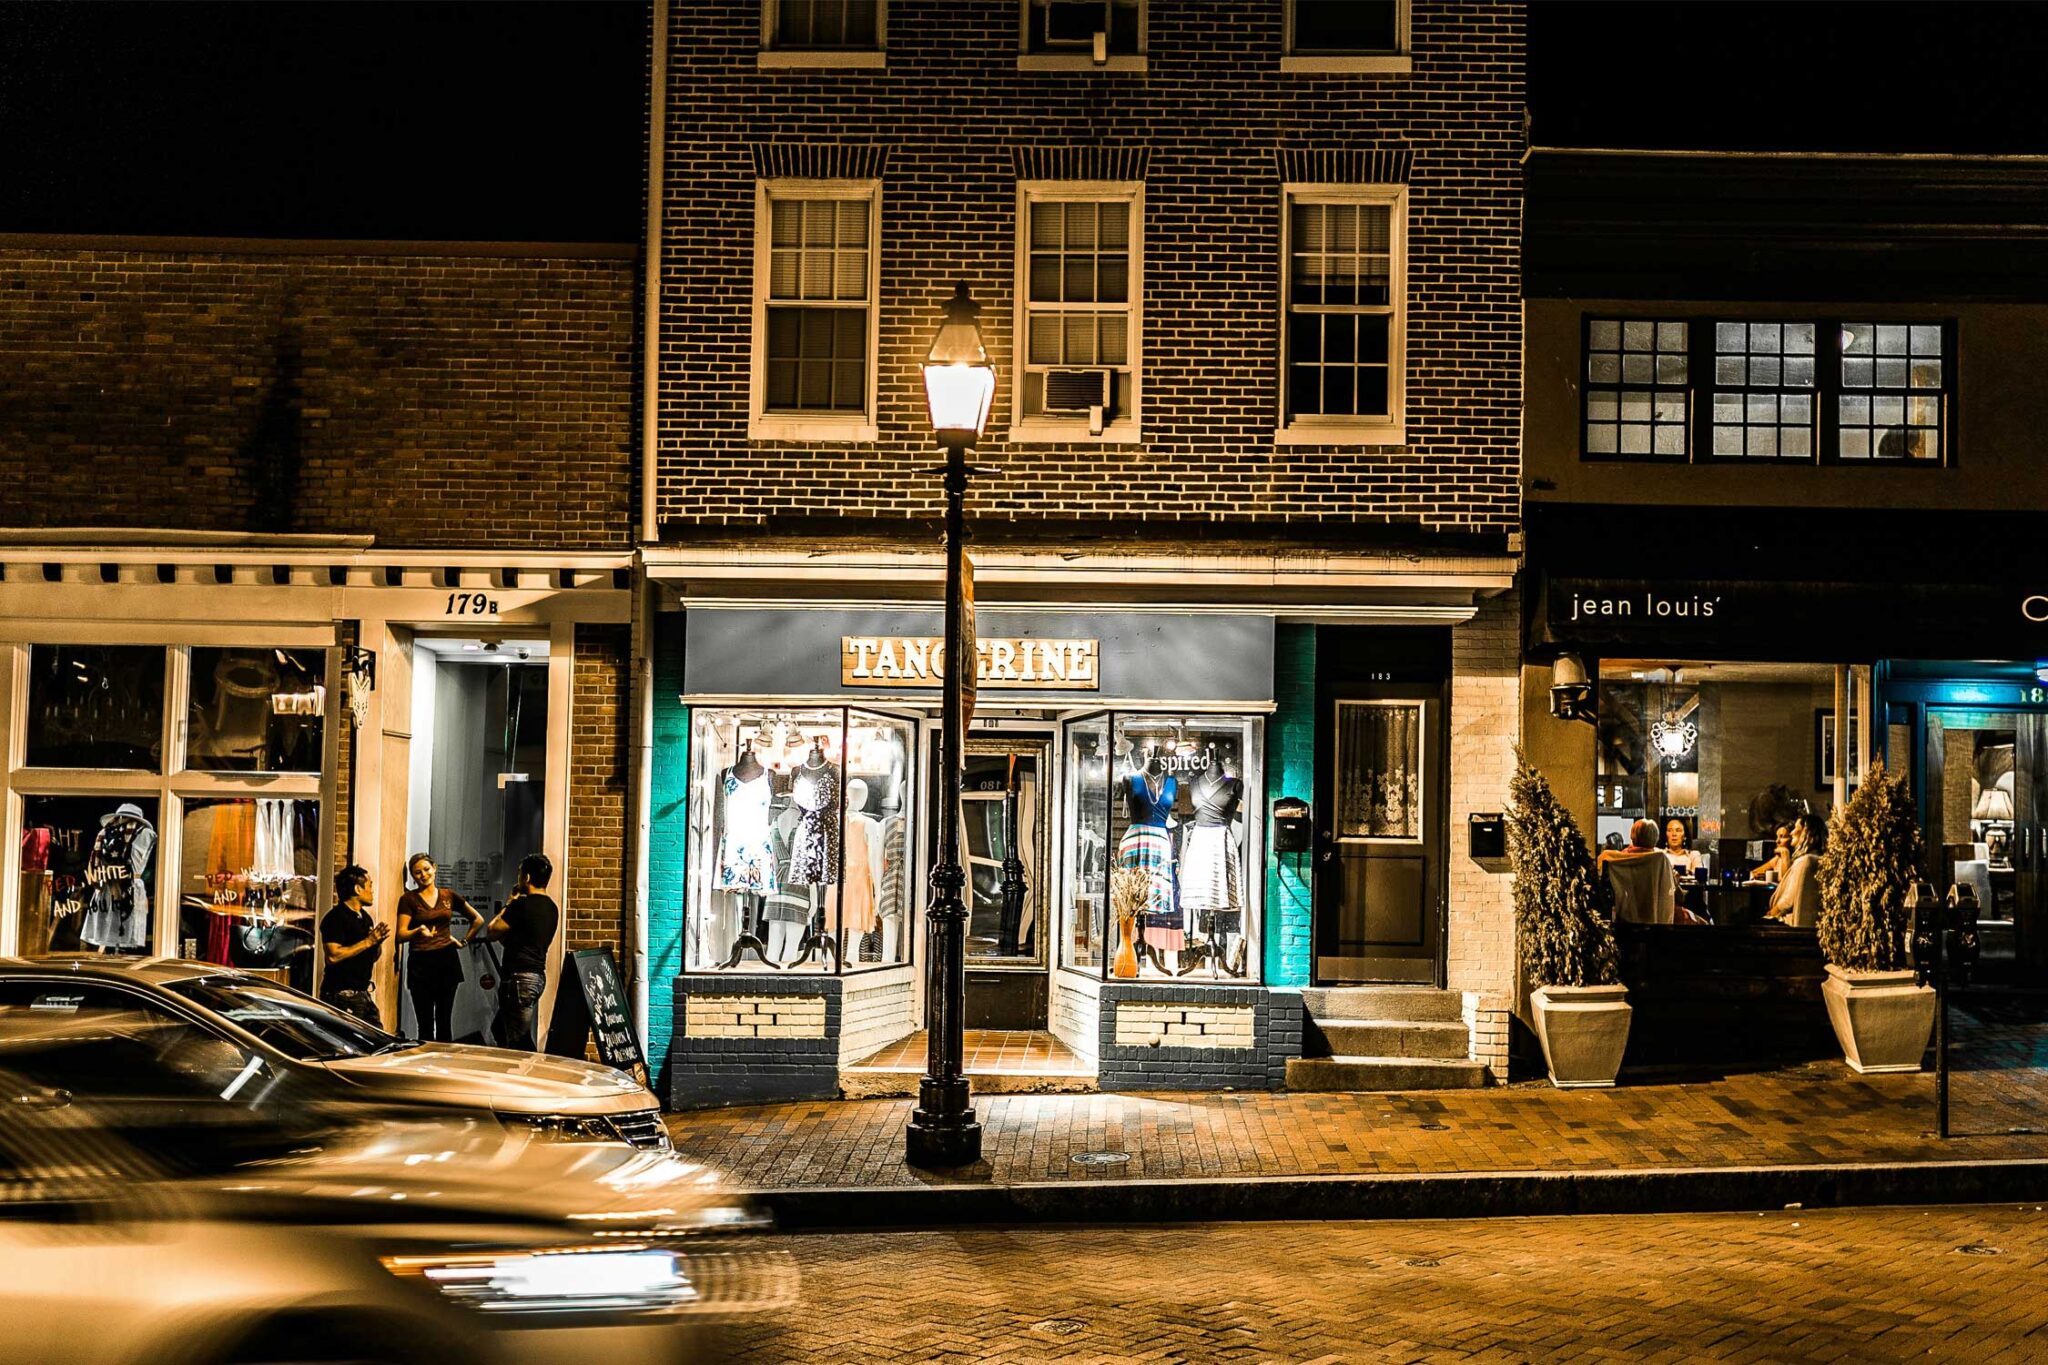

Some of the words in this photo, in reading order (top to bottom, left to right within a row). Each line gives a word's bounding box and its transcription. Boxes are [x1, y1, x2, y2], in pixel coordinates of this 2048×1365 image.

[446, 593, 498, 615] 179B
[1571, 593, 1631, 621] jean
[1371, 672, 1391, 680] 183
[2020, 687, 2048, 703] 18
[213, 888, 238, 906] AND
[53, 899, 81, 919] AND
